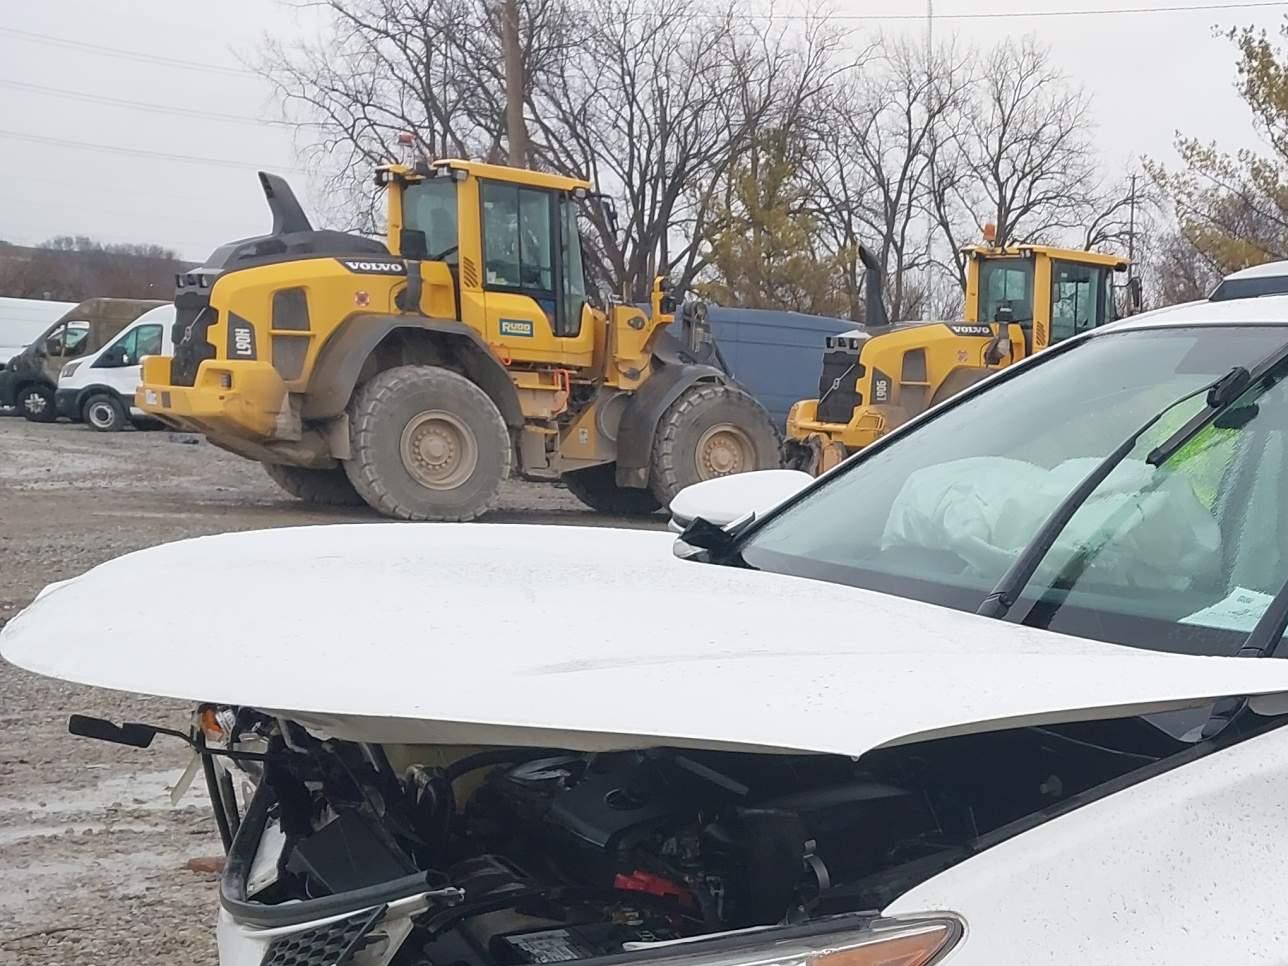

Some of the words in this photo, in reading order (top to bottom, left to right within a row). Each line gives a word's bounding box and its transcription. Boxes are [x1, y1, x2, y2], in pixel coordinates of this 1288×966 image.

[345, 261, 403, 272] VOLVO
[952, 326, 990, 334] VOLVO
[234, 328, 252, 355] L90H
